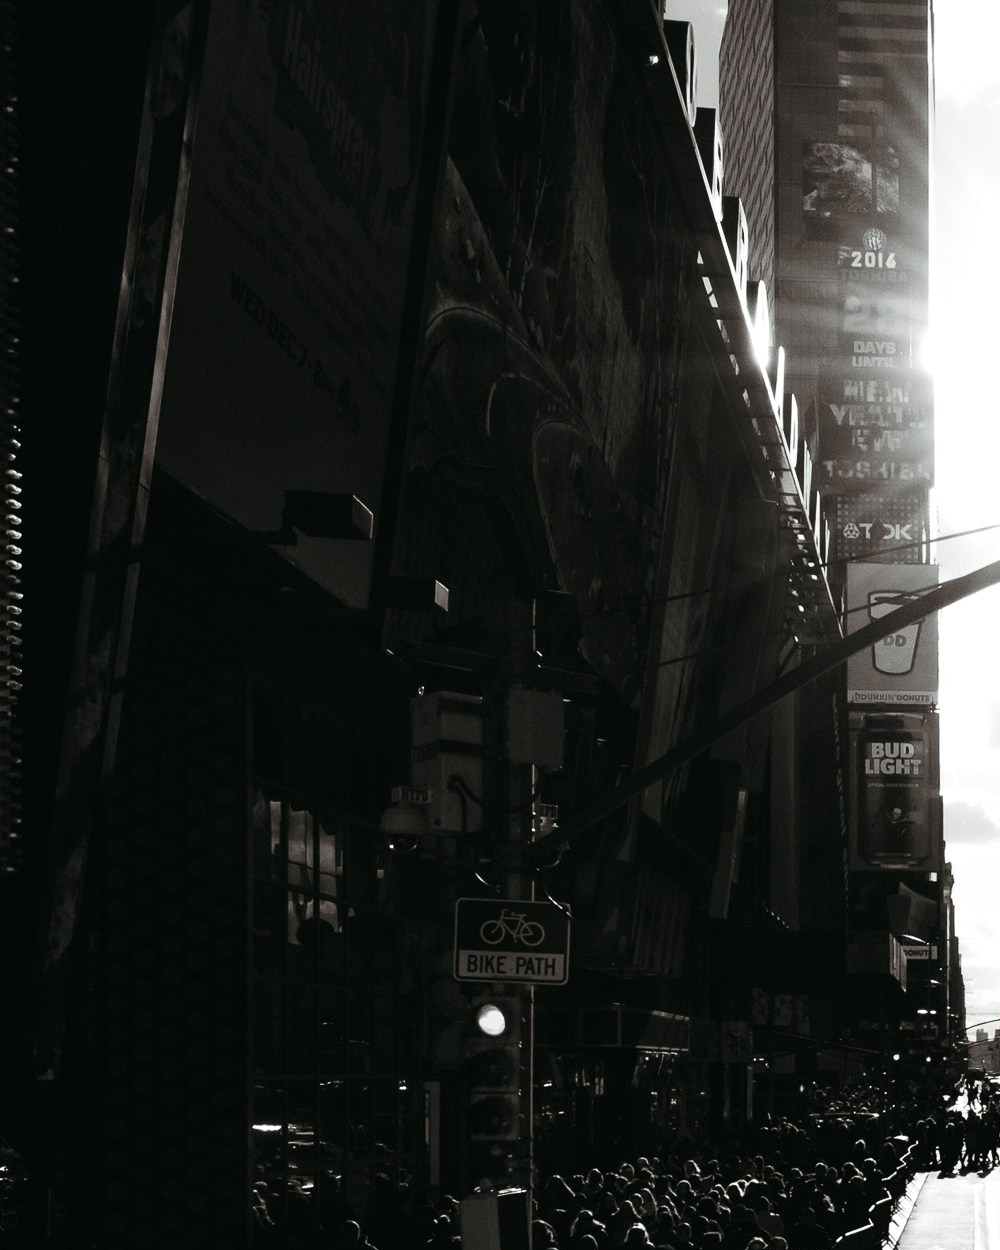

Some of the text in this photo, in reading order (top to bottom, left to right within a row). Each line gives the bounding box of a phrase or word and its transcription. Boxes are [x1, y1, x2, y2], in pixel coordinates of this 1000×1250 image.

[853, 340, 896, 354] DAYS
[851, 356, 898, 368] UNTIL
[883, 634, 908, 648] DD
[897, 694, 930, 702] DONUTS
[871, 742, 915, 758] BUD
[864, 758, 921, 775] LIGHT
[467, 954, 556, 976] BIKE PATH
